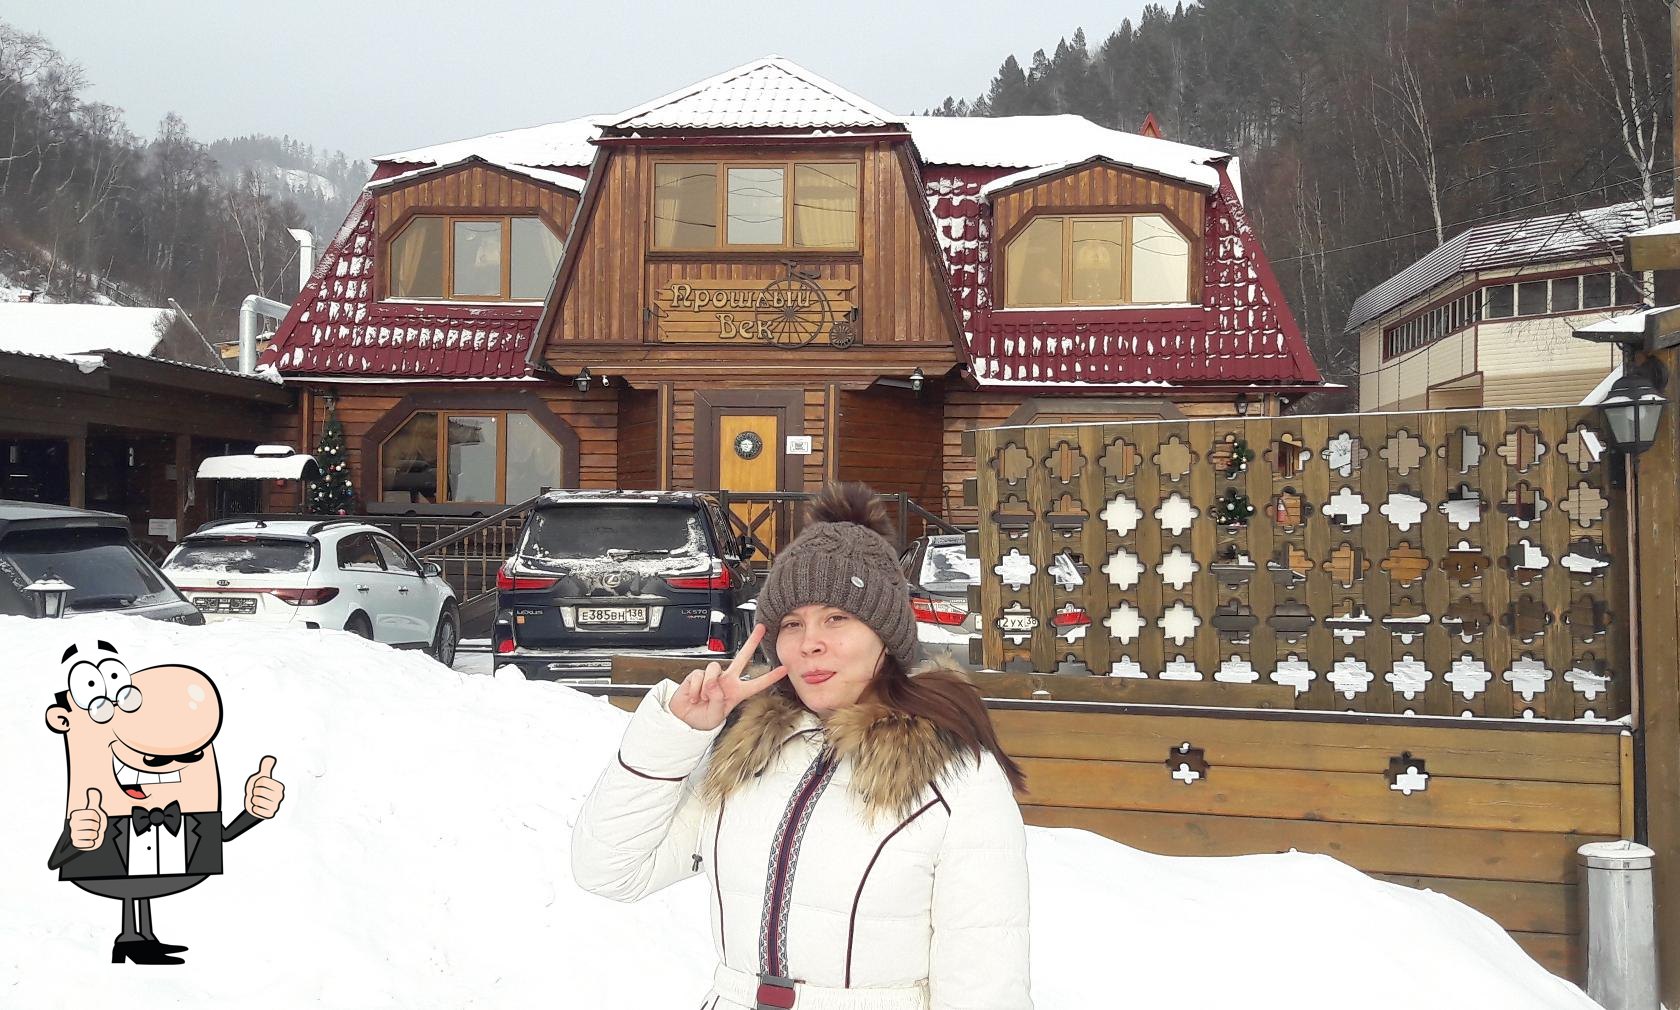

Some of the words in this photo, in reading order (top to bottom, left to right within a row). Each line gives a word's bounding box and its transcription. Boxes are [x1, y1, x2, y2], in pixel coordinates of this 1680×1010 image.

[671, 283, 811, 312] Прошлый
[715, 312, 774, 339] Век
[627, 608, 644, 618] 138
